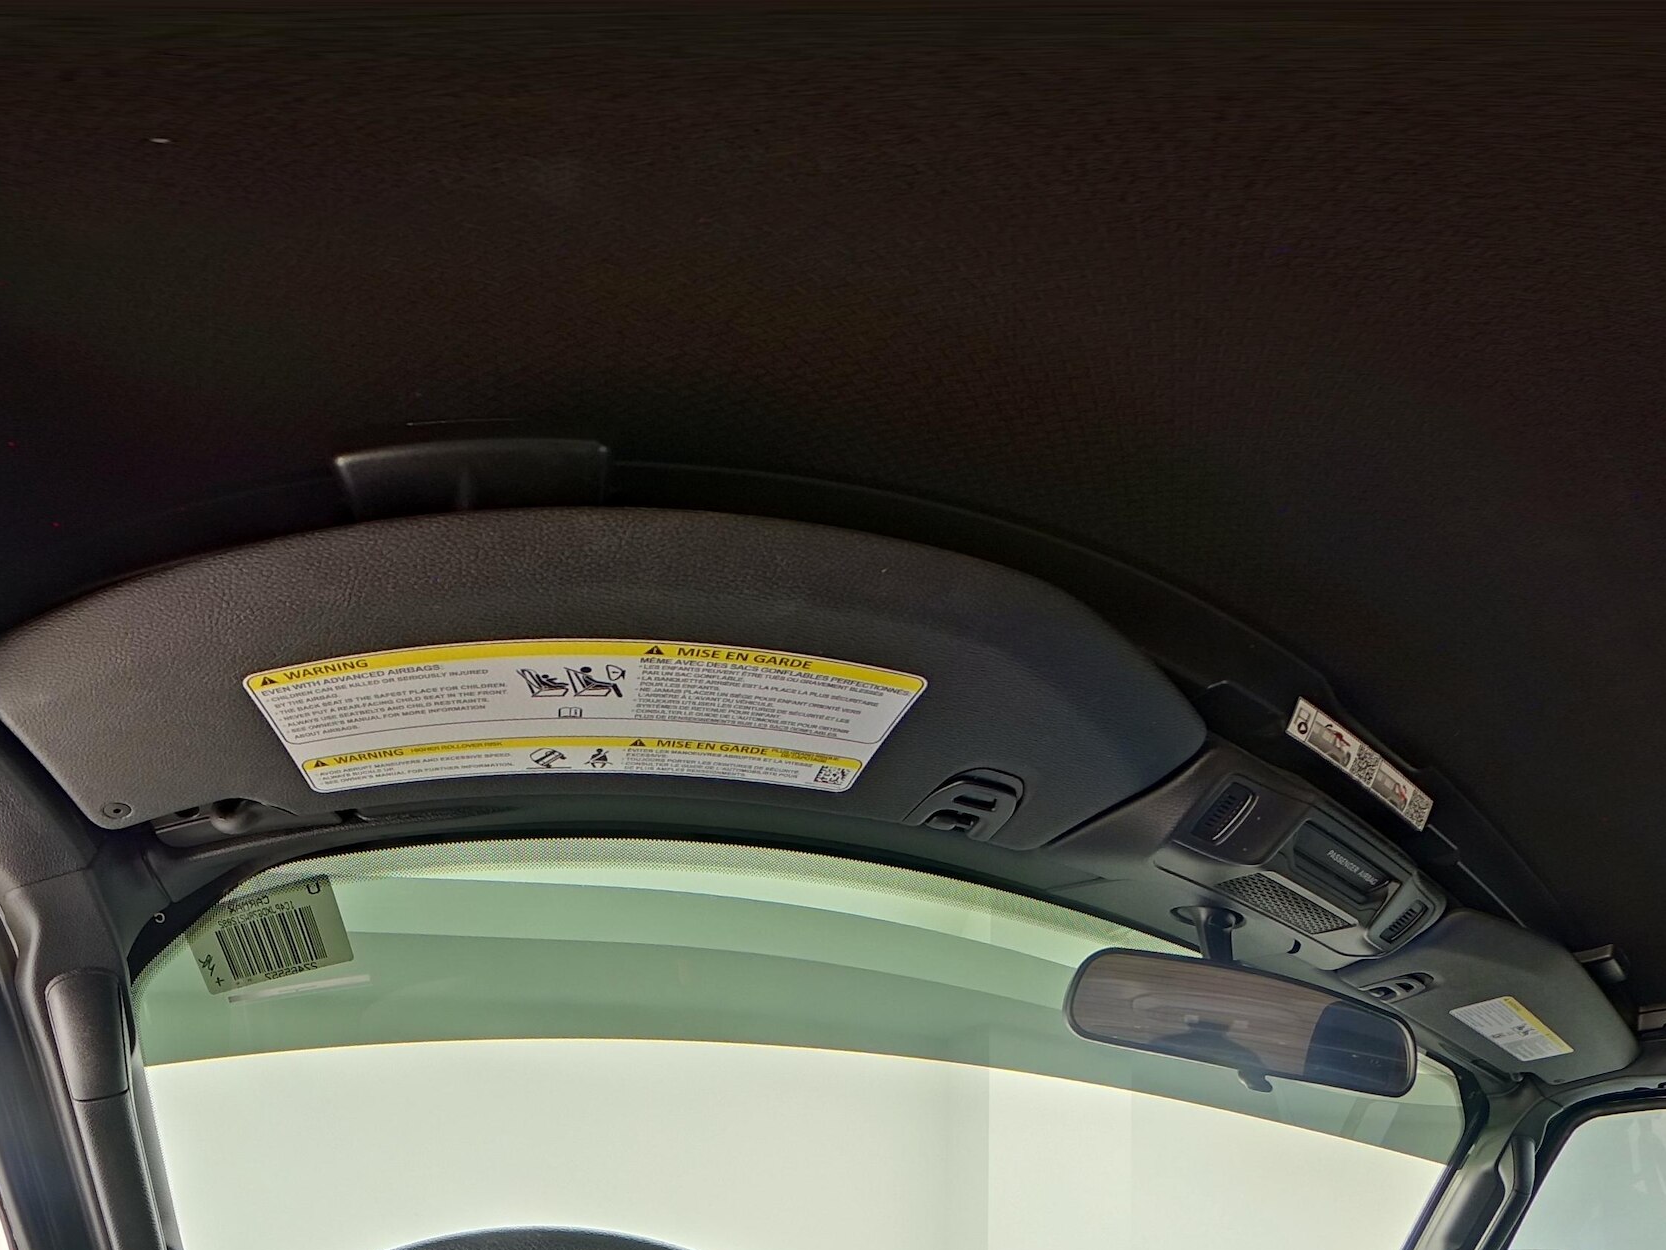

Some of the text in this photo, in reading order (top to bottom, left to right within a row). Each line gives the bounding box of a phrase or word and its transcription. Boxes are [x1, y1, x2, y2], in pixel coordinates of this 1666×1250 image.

[283, 659, 368, 681] WARNING
[677, 647, 813, 670] MISE EN GARDE
[262, 685, 290, 697] EVEN
[292, 679, 321, 691] WITH
[321, 671, 385, 687] ADVANCED
[271, 690, 312, 702] CHILDREN
[315, 686, 332, 695] CAN
[348, 679, 380, 688] KILLED
[397, 672, 446, 682] SERIOUSLY
[449, 669, 489, 677] INJURED
[333, 748, 404, 765] WARNING
[656, 739, 692, 749] MISE
[696, 743, 716, 751] EN
[719, 744, 768, 756] GARDE
[1326, 849, 1379, 886] PASSENGER AIRBAG
